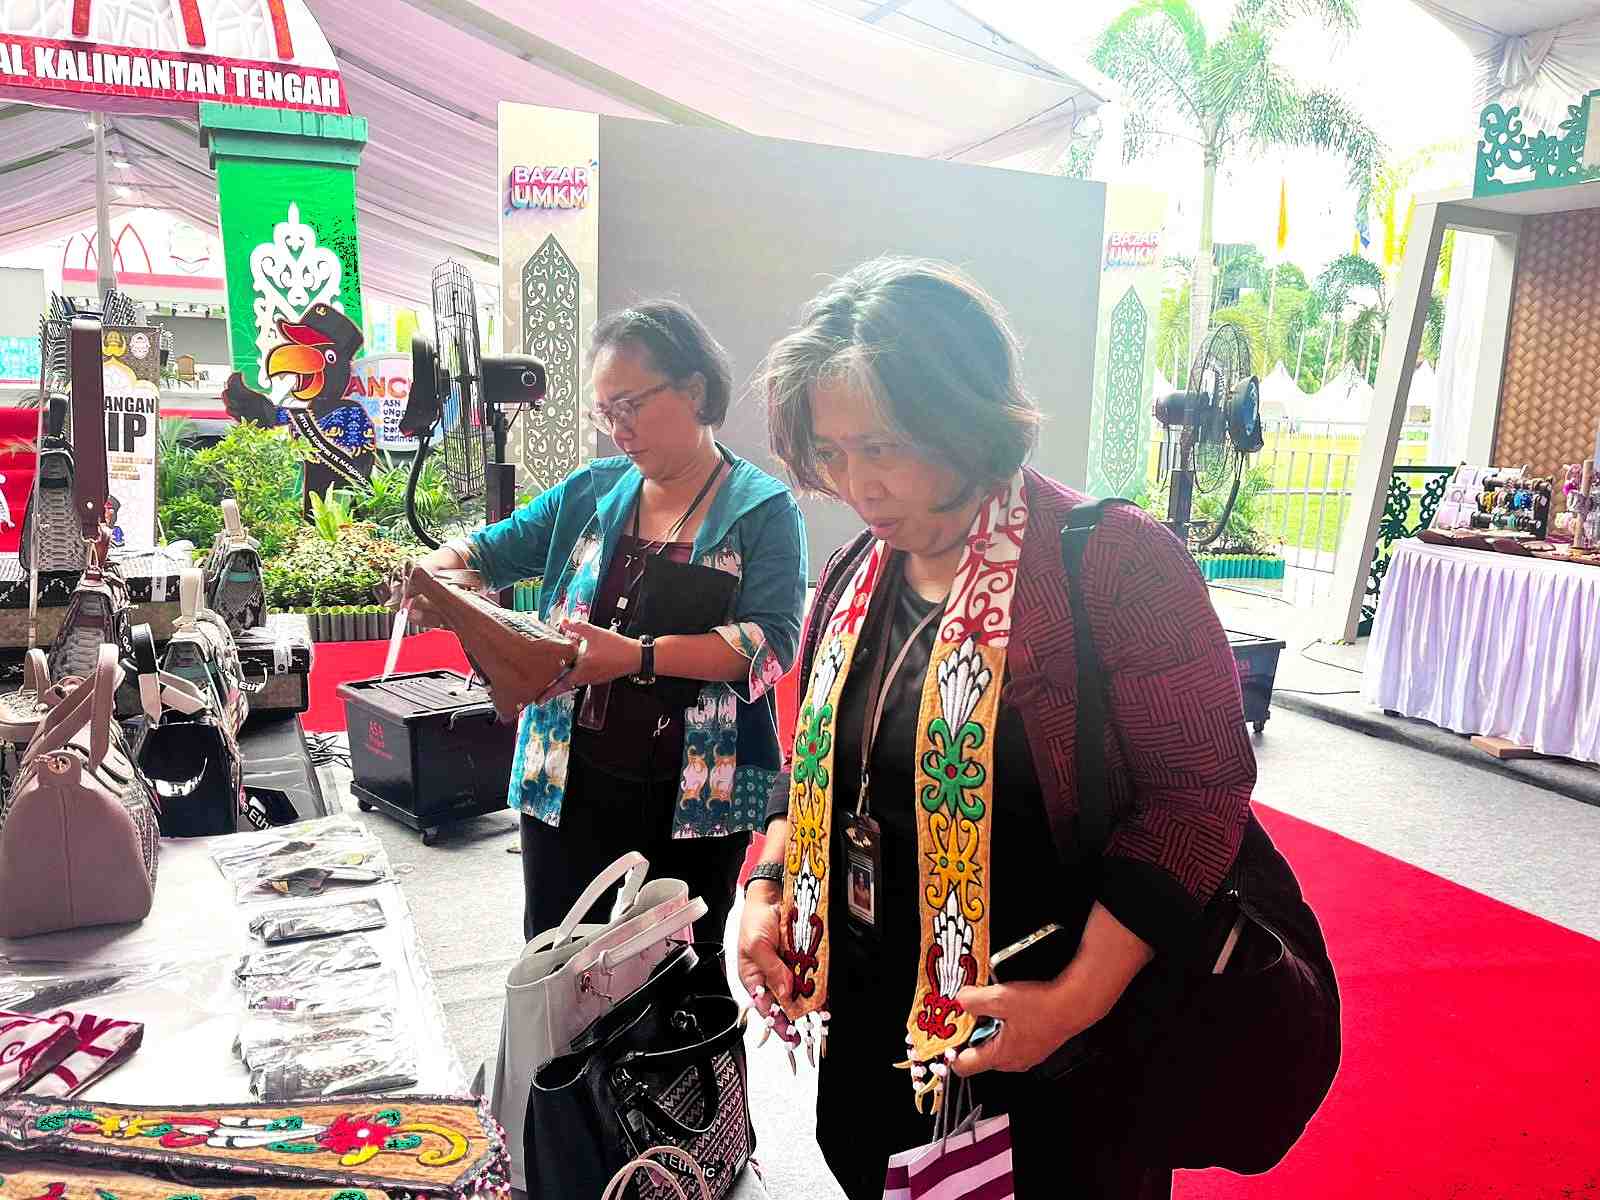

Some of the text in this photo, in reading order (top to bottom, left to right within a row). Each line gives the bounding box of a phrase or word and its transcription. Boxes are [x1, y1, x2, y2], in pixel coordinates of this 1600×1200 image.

[35, 48, 226, 95] KALIMANTAN
[233, 68, 340, 107] TENGAH
[511, 166, 587, 185] BAZAR
[511, 184, 589, 209] UMKM
